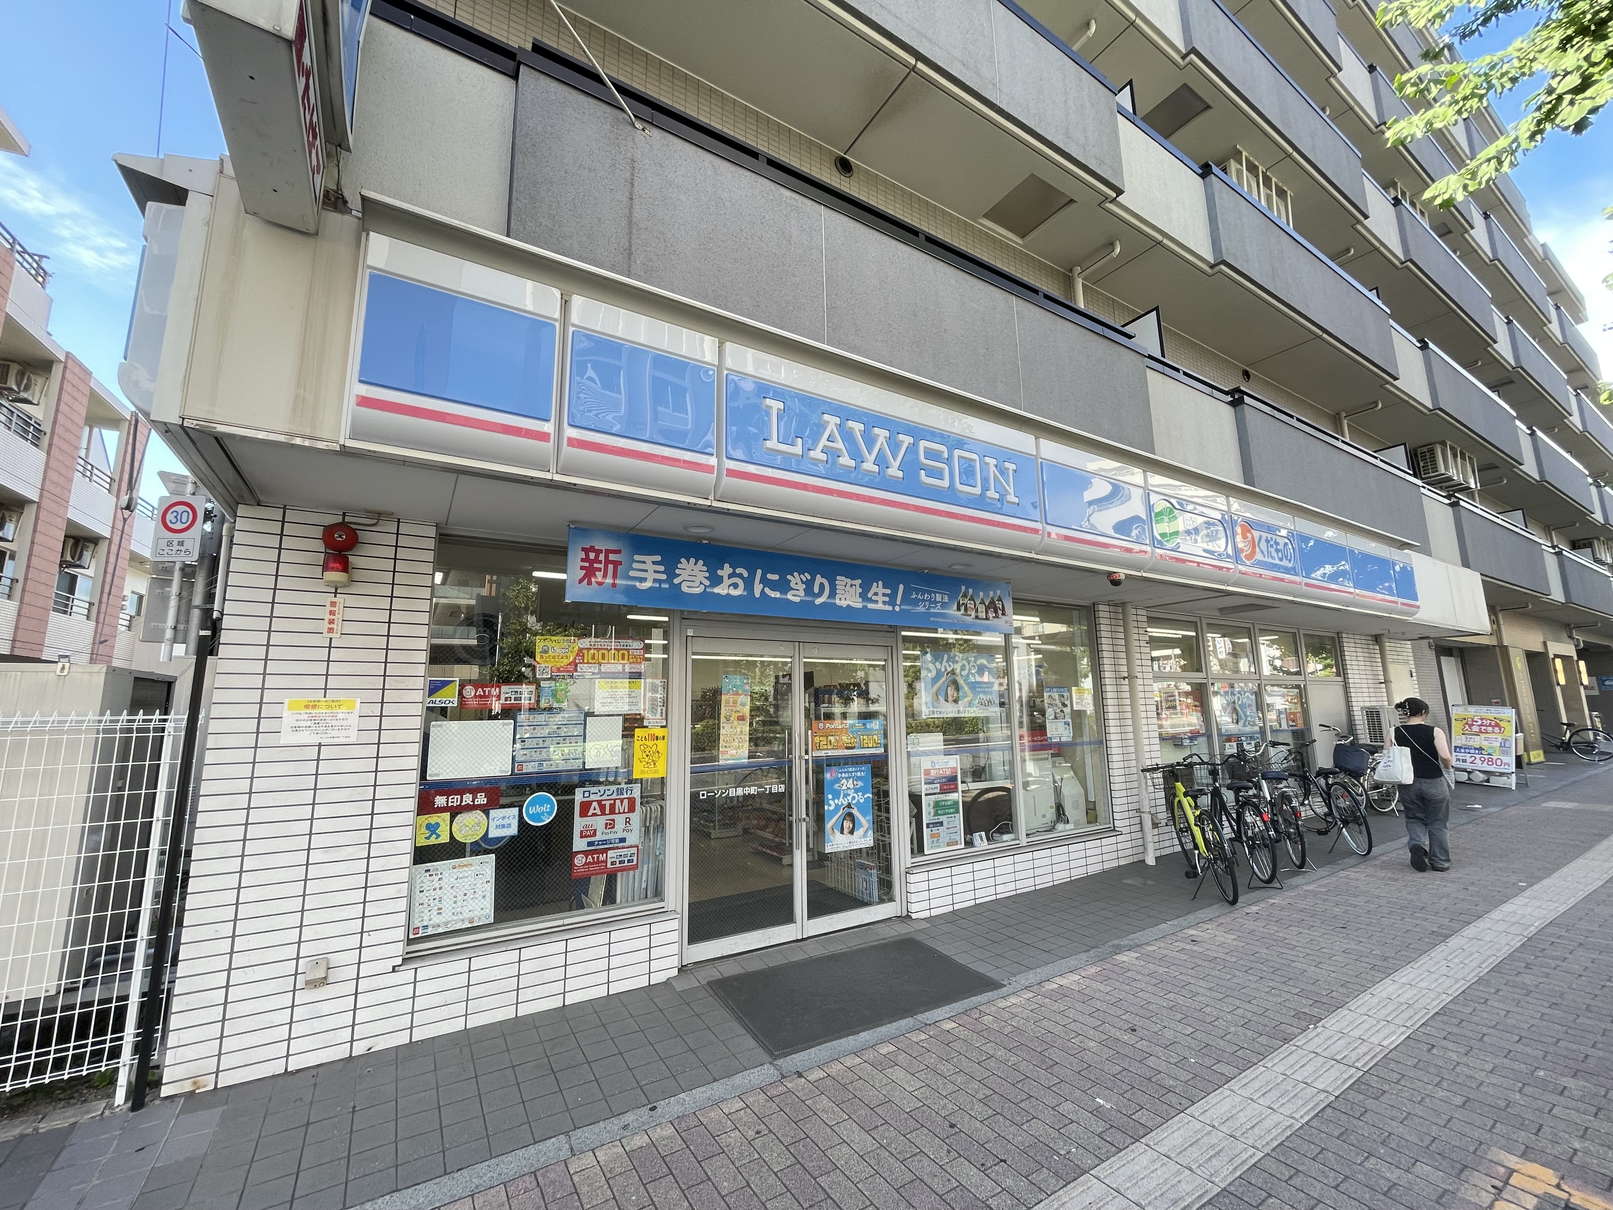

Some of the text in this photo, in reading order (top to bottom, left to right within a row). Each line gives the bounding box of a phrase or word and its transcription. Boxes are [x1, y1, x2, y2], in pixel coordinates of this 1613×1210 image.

[763, 396, 1020, 506] LAWSON
[169, 510, 190, 525] 30
[166, 540, 185, 548] 区域
[158, 548, 192, 556] ここから
[1257, 535, 1294, 566] くだもの
[475, 687, 500, 696] ATM
[582, 786, 634, 798] ローソン銀行
[434, 792, 488, 808] 無印良品
[528, 804, 551, 813] Wolt
[587, 799, 629, 816] ATM
[586, 853, 607, 863] ATM
